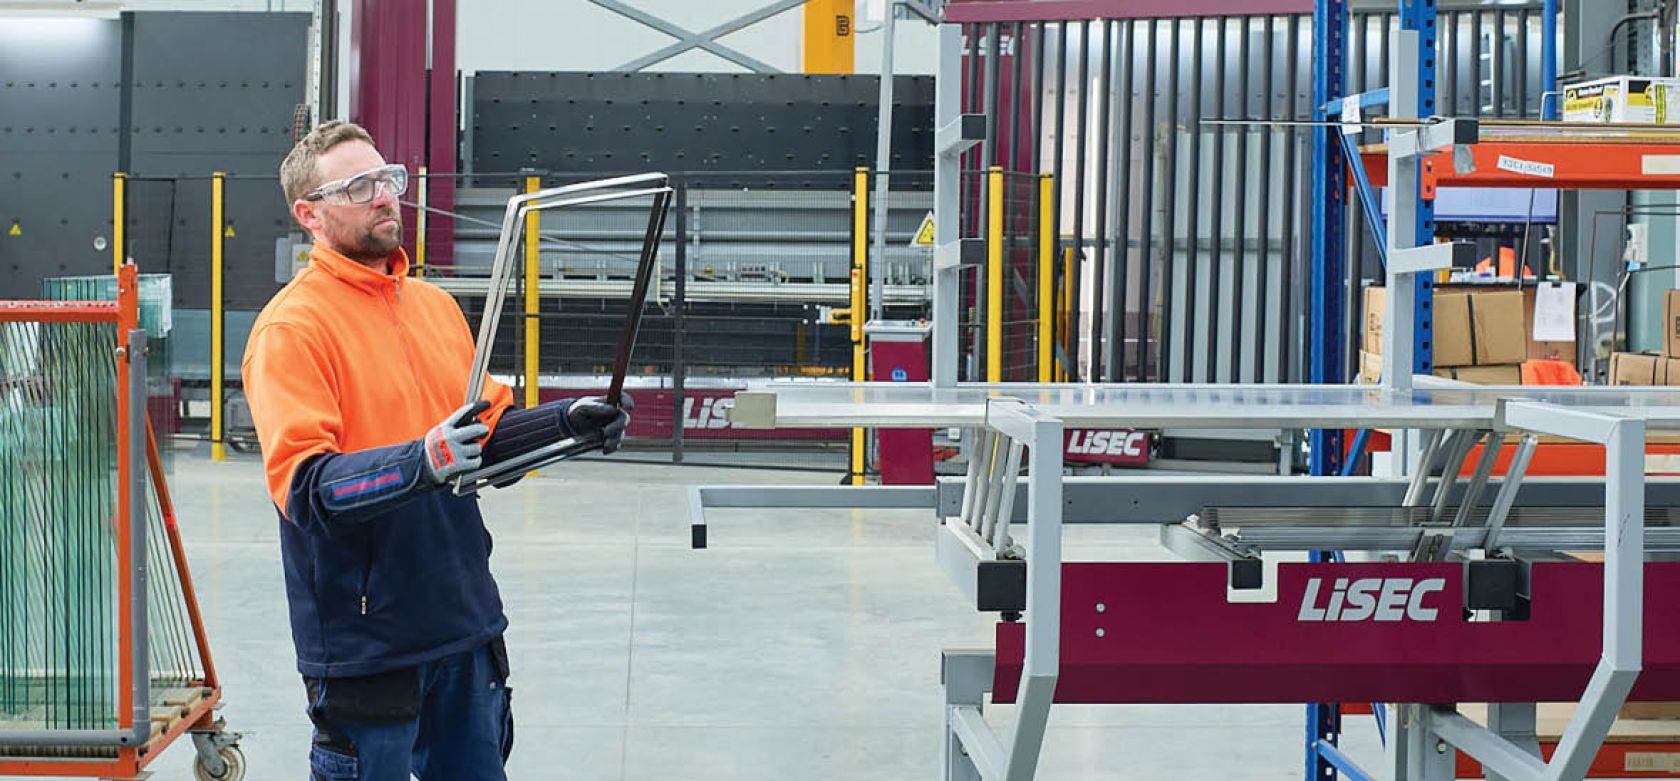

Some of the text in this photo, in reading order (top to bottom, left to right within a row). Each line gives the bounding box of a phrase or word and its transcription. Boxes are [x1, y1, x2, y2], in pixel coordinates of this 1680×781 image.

[683, 397, 744, 429] LiS
[1067, 430, 1144, 456] LiSEC
[1297, 578, 1446, 622] LiSEC
